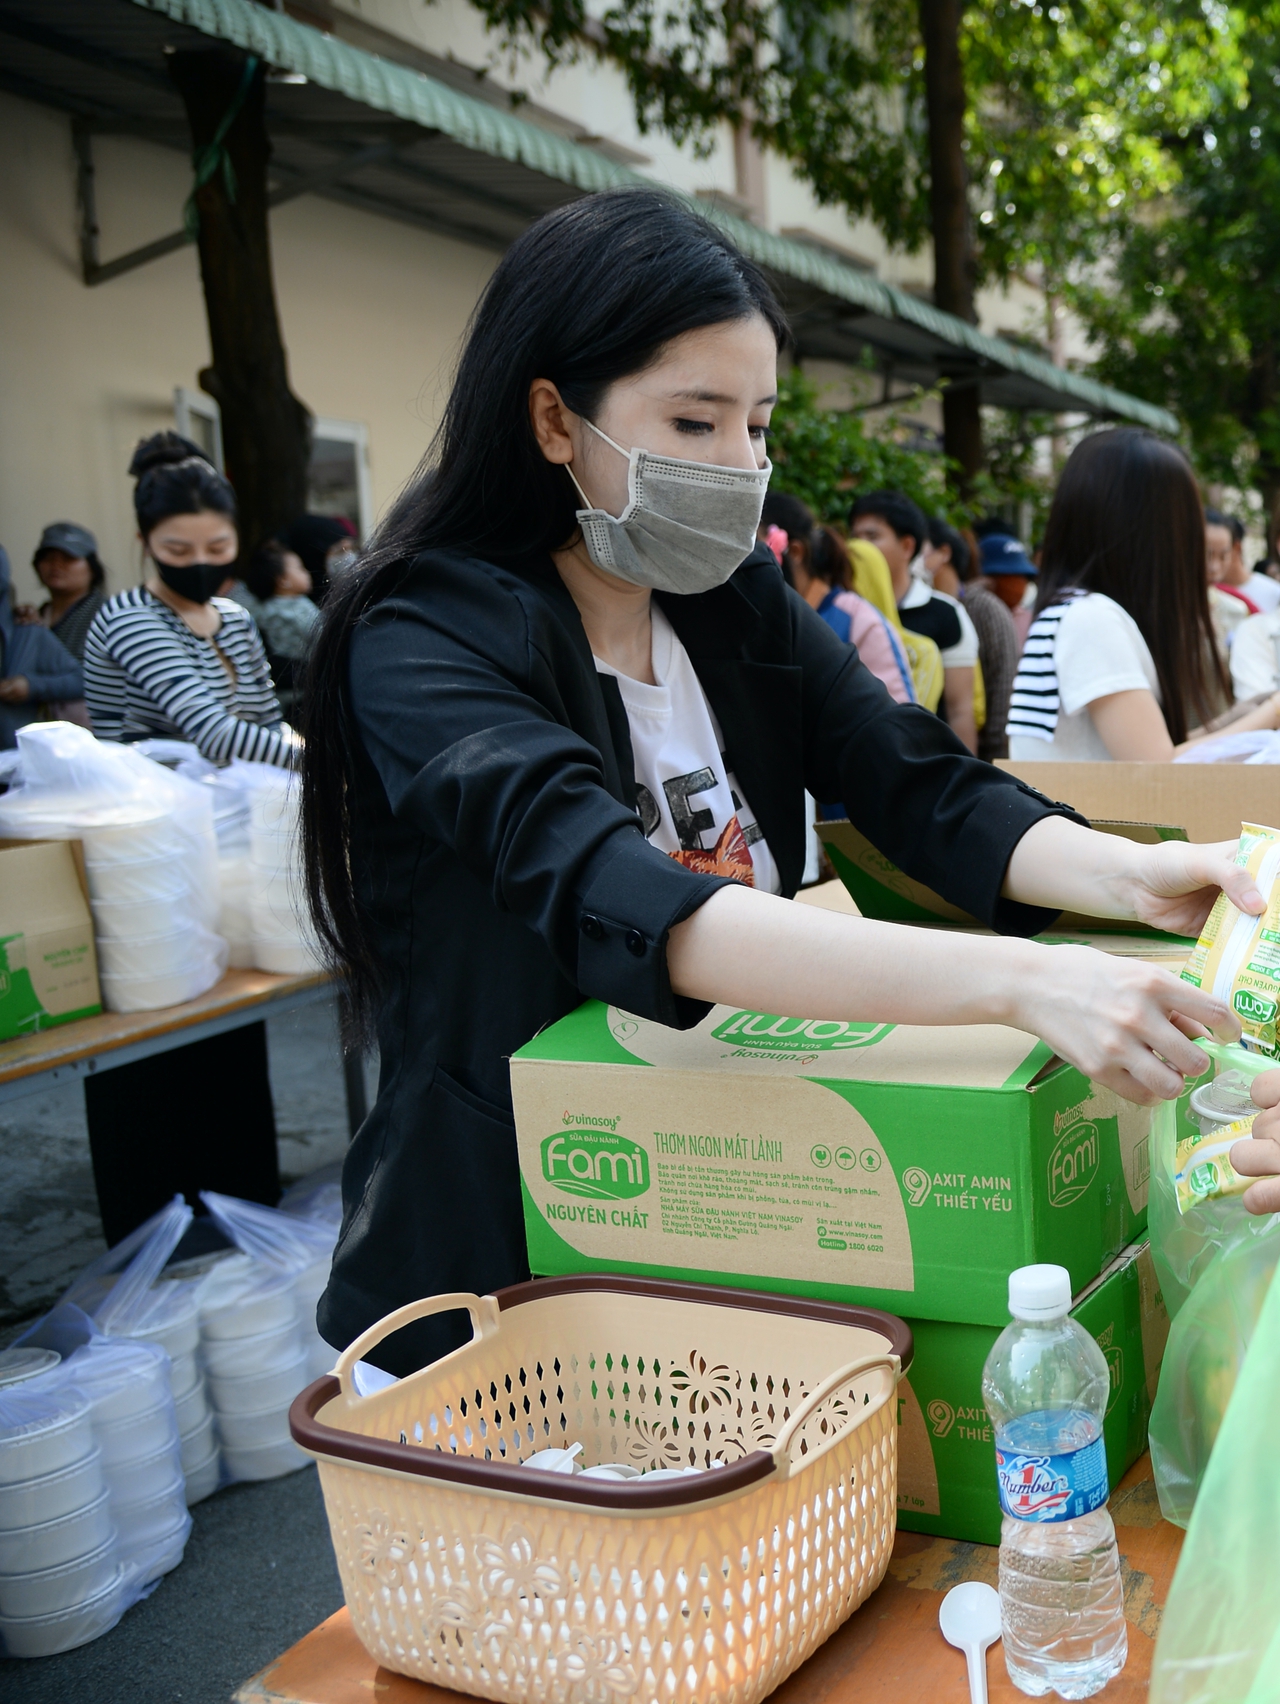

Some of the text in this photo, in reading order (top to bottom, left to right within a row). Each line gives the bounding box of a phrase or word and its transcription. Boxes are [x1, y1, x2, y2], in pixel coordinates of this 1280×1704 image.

[653, 1132, 782, 1162] THƠM NGON MÁT LÀNH
[902, 1166, 932, 1207] 9
[933, 1173, 1011, 1191] AXIT AMIN
[933, 1190, 1012, 1211] THIẾT YẾU
[546, 1203, 649, 1229] NGUYÊN CHẤT
[820, 1240, 883, 1252] Hotline 1800 6020
[927, 1399, 955, 1437] 9
[957, 1406, 988, 1421] AXIT
[958, 1425, 995, 1442] THIẾ
[1000, 1472, 1063, 1495] Number
